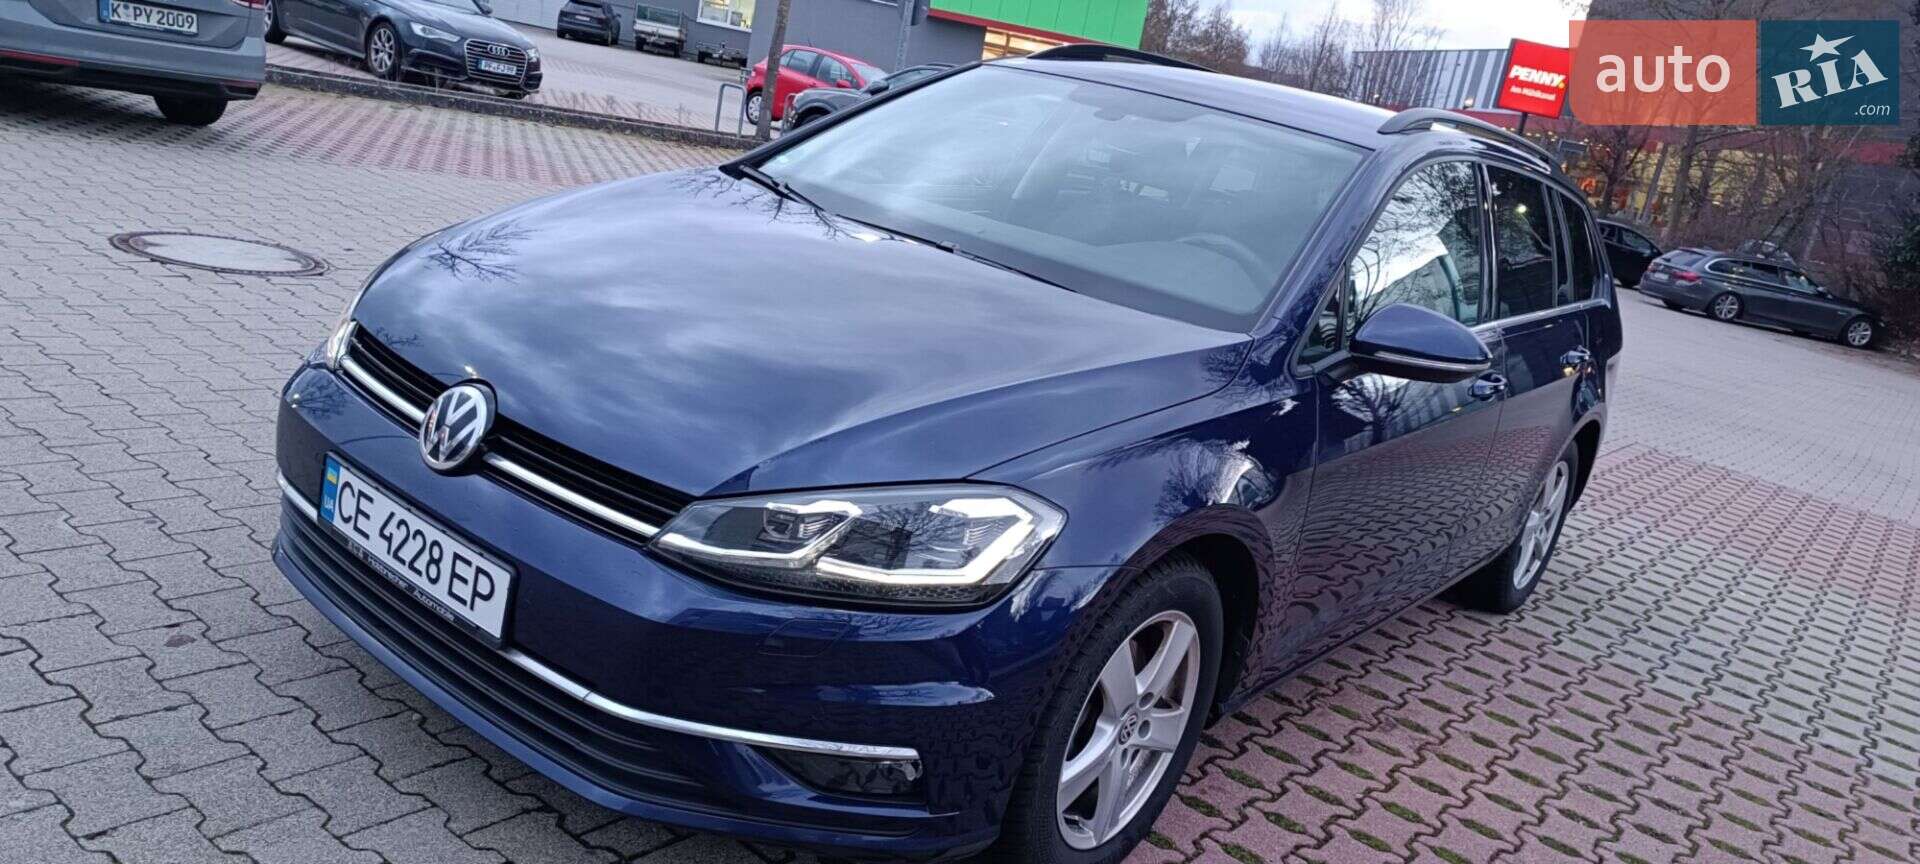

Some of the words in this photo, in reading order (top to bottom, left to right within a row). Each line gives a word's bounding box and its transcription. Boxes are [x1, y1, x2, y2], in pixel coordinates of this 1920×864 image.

[111, 3, 121, 19] K
[133, 6, 153, 23] PY
[156, 10, 194, 29] 2009
[338, 480, 374, 541] CE
[378, 511, 444, 586] 4228
[448, 551, 496, 612] EP
